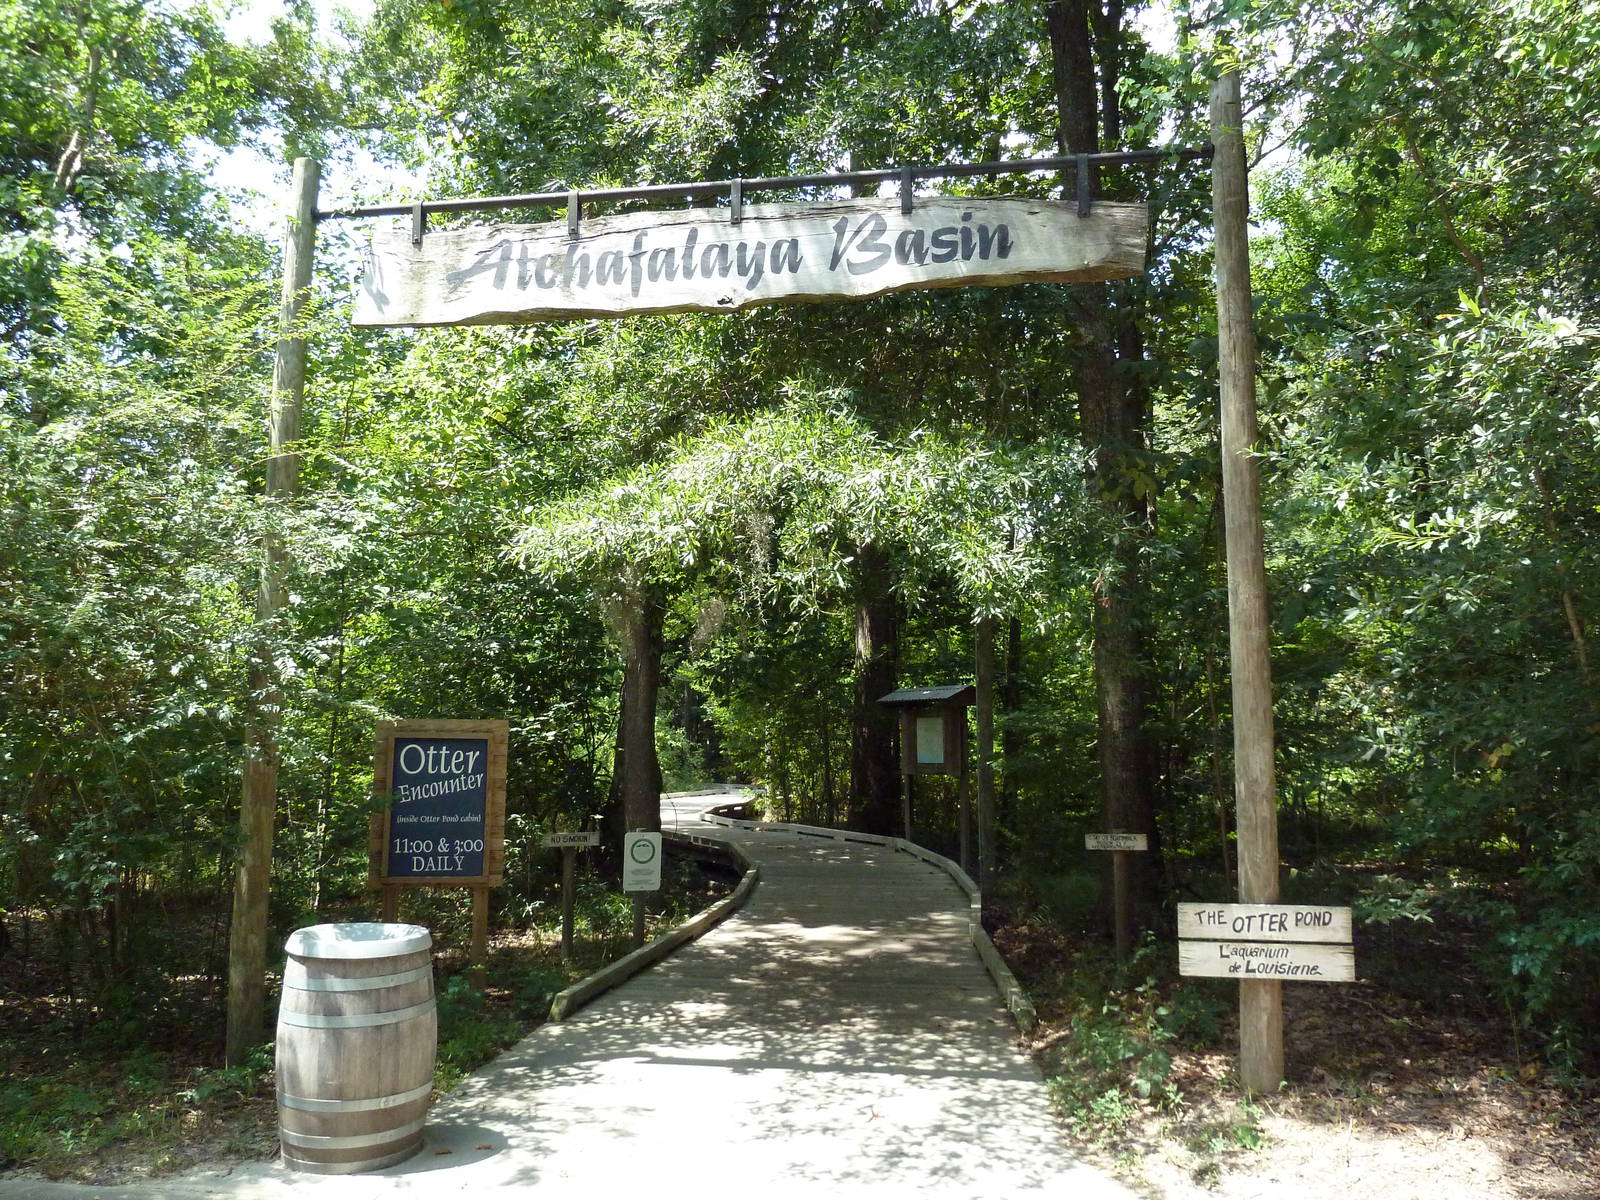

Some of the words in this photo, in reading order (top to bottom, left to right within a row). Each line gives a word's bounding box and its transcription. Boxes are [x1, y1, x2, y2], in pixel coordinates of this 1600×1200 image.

[446, 227, 802, 297] Atchafalaya
[829, 212, 1013, 275] Basin
[400, 744, 480, 775] Otter
[398, 773, 483, 803] Encounter
[420, 815, 440, 823] Otter
[442, 814, 459, 823] Pond
[394, 839, 433, 854] 11:00
[438, 838, 449, 852] &
[454, 839, 484, 856] 3:00
[551, 835, 560, 844] NO
[412, 856, 464, 872] DAILY
[1194, 910, 1227, 925] THE
[1232, 912, 1288, 933] OTTER
[1295, 911, 1332, 927] POND
[1219, 944, 1289, 960] L'aquarium
[1228, 962, 1243, 973] de
[1245, 960, 1323, 976] Louisiane
